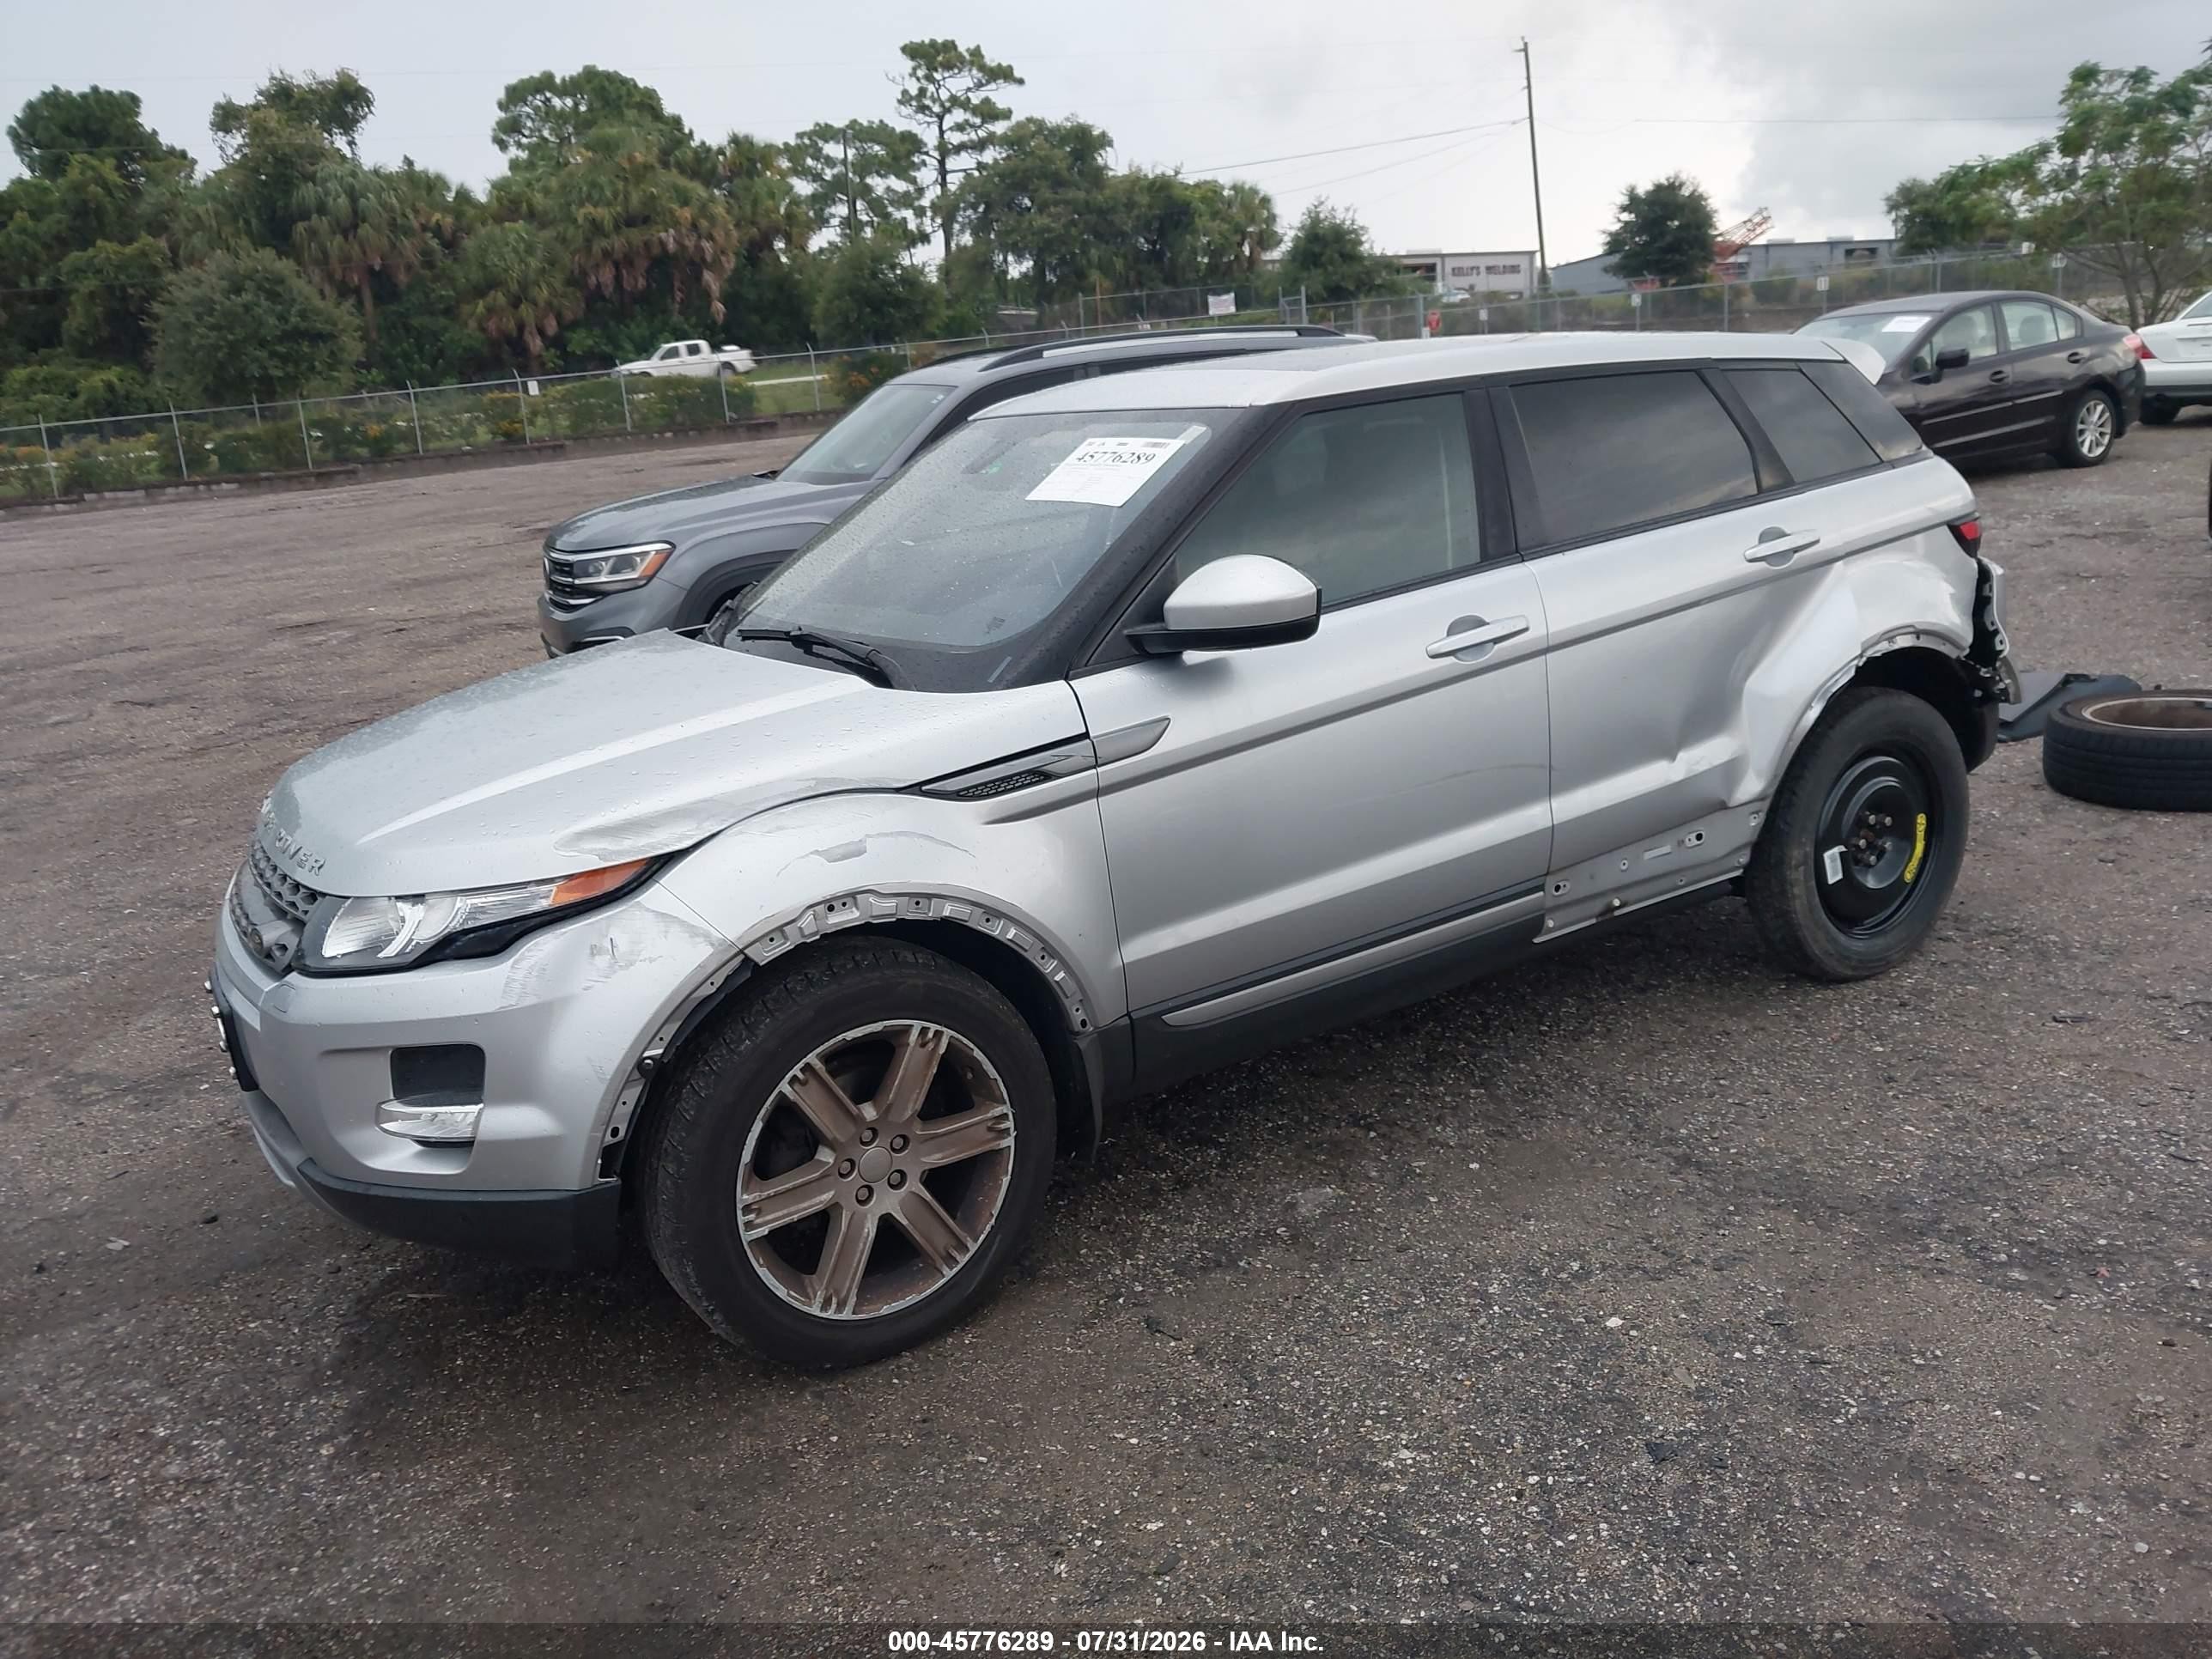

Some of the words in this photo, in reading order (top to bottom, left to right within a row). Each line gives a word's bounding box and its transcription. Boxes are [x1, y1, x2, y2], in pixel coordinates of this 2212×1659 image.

[1451, 265, 1481, 277] KELLY'S
[1485, 264, 1522, 276] WELDING
[1075, 450, 1158, 465] 45776289
